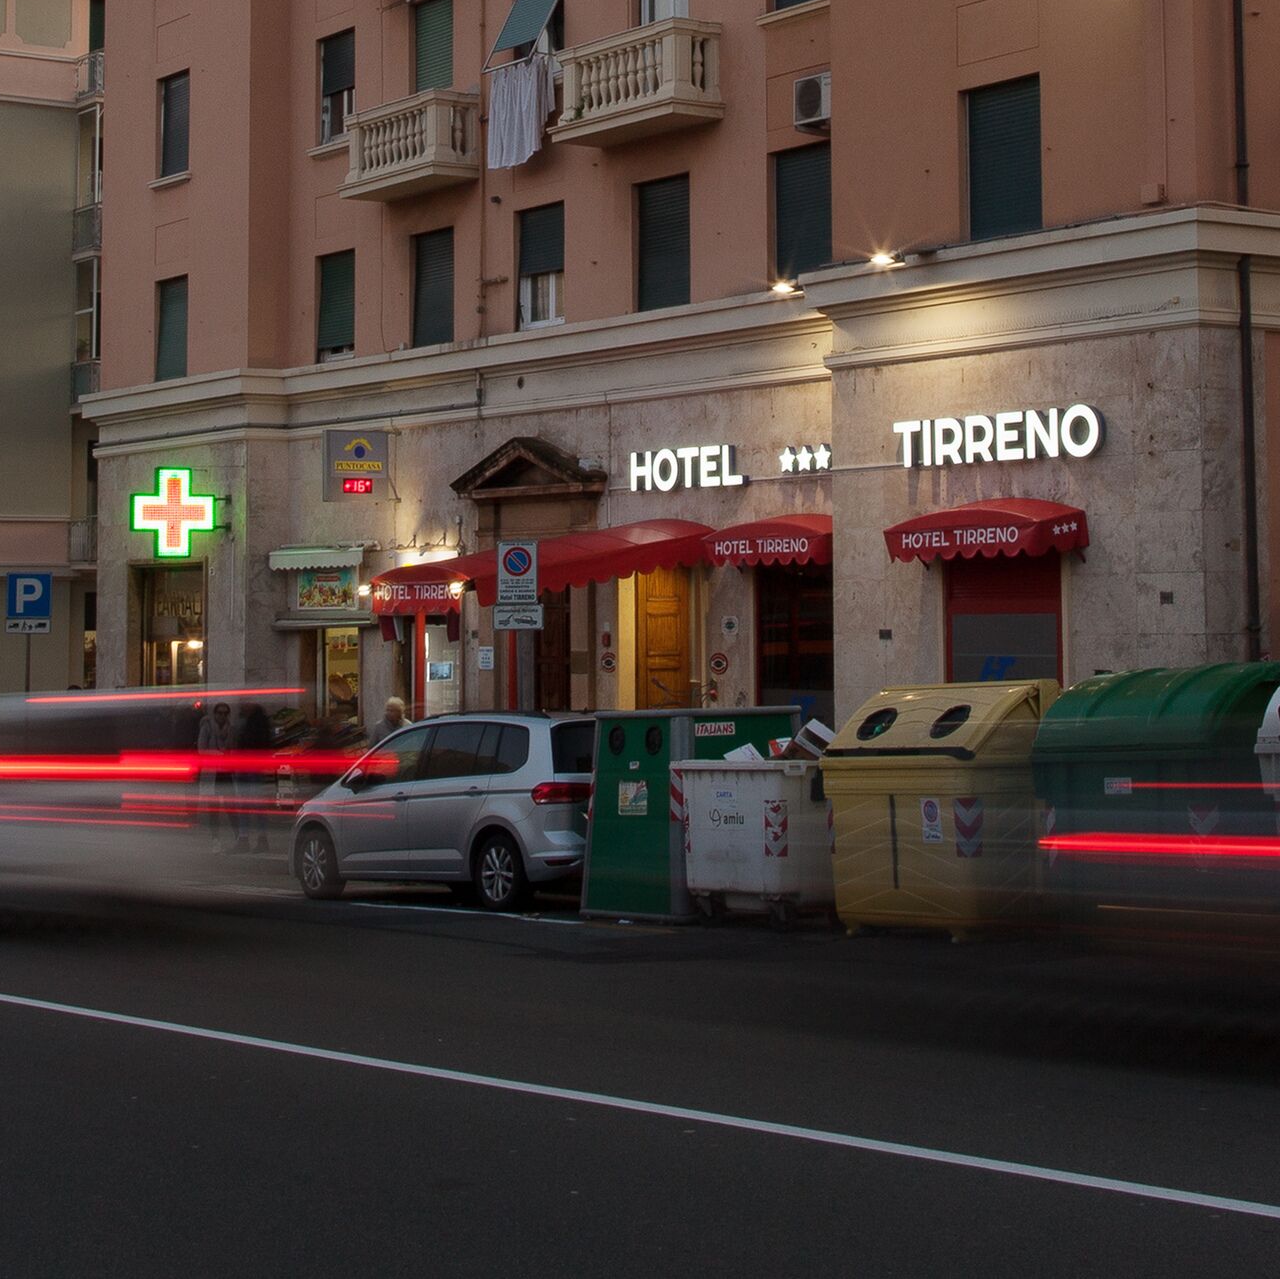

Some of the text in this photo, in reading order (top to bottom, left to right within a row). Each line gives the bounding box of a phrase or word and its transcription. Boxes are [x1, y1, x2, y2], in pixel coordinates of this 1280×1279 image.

[893, 403, 1102, 468] TIRRENO
[336, 462, 381, 470] PUNTOCASA
[630, 444, 746, 492] HOTEL
[715, 537, 809, 555] HOTEL TIRRENO
[902, 526, 1019, 549] HOTEL TIRRENO
[16, 578, 43, 613] P
[376, 584, 411, 600] HOTEL
[696, 723, 734, 735] ITALIANS
[724, 812, 744, 824] amiu
